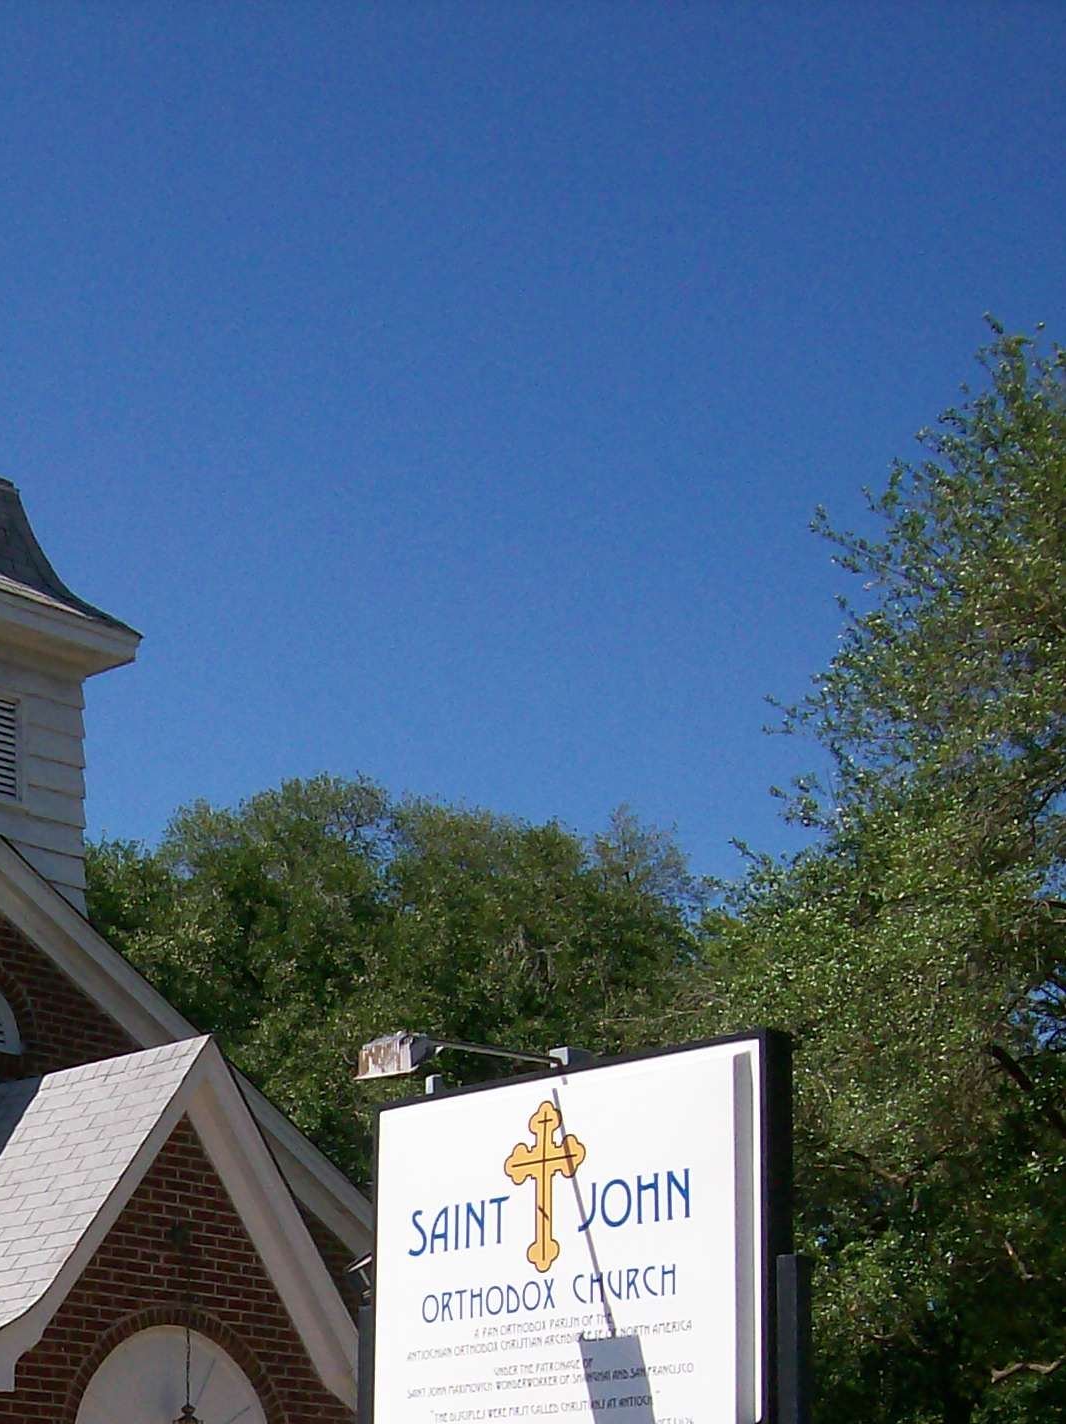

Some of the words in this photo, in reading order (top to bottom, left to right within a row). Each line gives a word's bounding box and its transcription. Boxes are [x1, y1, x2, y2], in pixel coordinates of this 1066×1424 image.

[408, 1195, 511, 1257] SAINT
[577, 1168, 691, 1233] JOHN
[421, 1278, 556, 1323] ORTHODOX
[572, 1263, 677, 1305] CHURCH
[407, 1346, 452, 1361] ANTIOCHIAN
[454, 1342, 498, 1356] ORTHODOX
[500, 1336, 543, 1352] CHRISTIAN
[621, 1325, 650, 1338] NORTH
[652, 1319, 693, 1335] AMERICA
[500, 1320, 547, 1336] ORTHODOX
[550, 1316, 581, 1330] PARISH
[582, 1314, 593, 1327] OF
[407, 1387, 426, 1400] SAINT
[428, 1385, 447, 1398] JOHN
[495, 1375, 559, 1391] WONDERWORKER
[560, 1375, 570, 1386] OF
[613, 1369, 629, 1381] AND
[630, 1367, 646, 1379] SAN
[647, 1362, 694, 1377] FRANCISCO
[494, 1364, 519, 1376] UNDER
[520, 1363, 534, 1375] THE
[536, 1359, 581, 1374] PATRONAGE
[583, 1358, 594, 1369] OF
[449, 1408, 485, 1422] DISCIPLES
[487, 1407, 508, 1419] WERE
[509, 1405, 529, 1417] FIRST
[530, 1402, 559, 1415] CALLED
